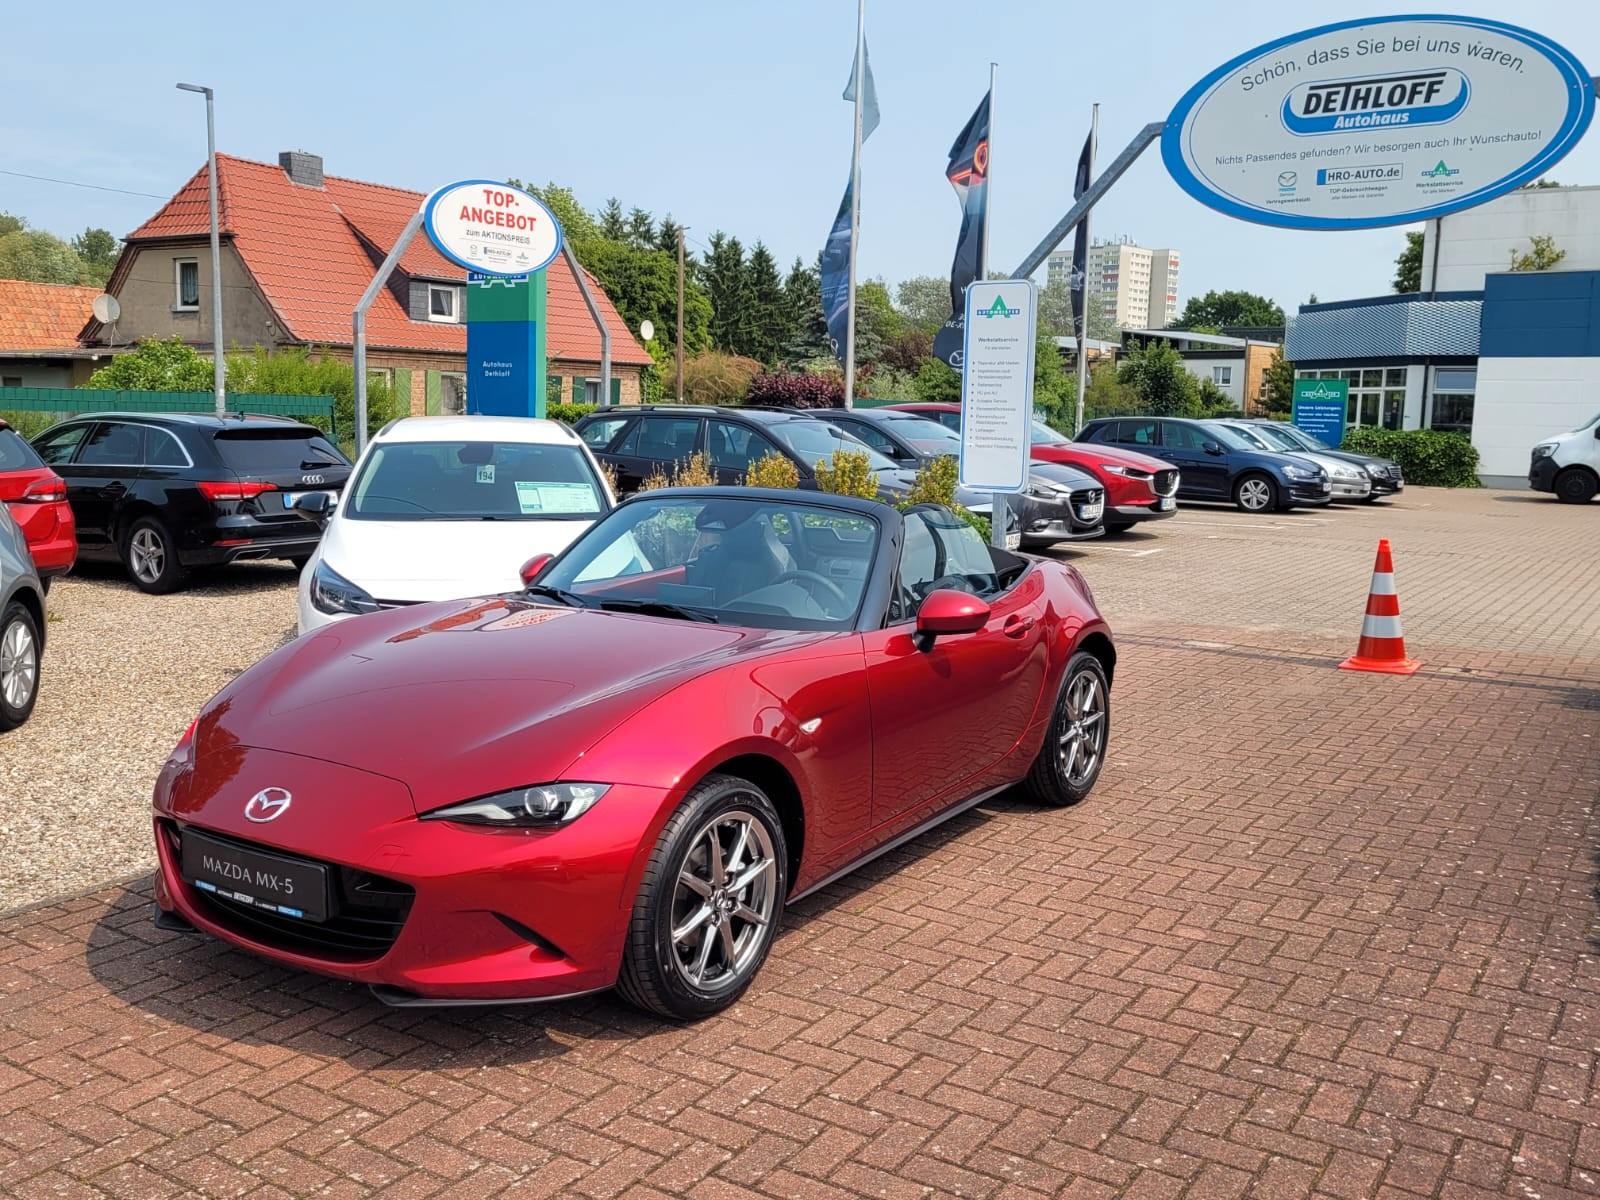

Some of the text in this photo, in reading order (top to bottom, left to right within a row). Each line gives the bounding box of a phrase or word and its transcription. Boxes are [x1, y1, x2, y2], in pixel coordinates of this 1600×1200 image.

[1241, 35, 1524, 91] Schön, dass Sie bei uns waren.
[1302, 71, 1447, 115] DETHLOFF
[1333, 110, 1410, 129] Autohaus
[1215, 130, 1542, 166] Nichts Passendes gefunden? Wir besorgen auch Ihr Wunschauto!
[1327, 167, 1400, 181] HRO-AUTO.de
[483, 189, 520, 208] TOP-
[459, 205, 537, 231] ANGEBOT
[466, 229, 531, 245] zum AKTIONSPREIS
[482, 360, 513, 368] Autohaus
[478, 471, 493, 481] 194
[203, 855, 294, 894] MAZDA MX-5
